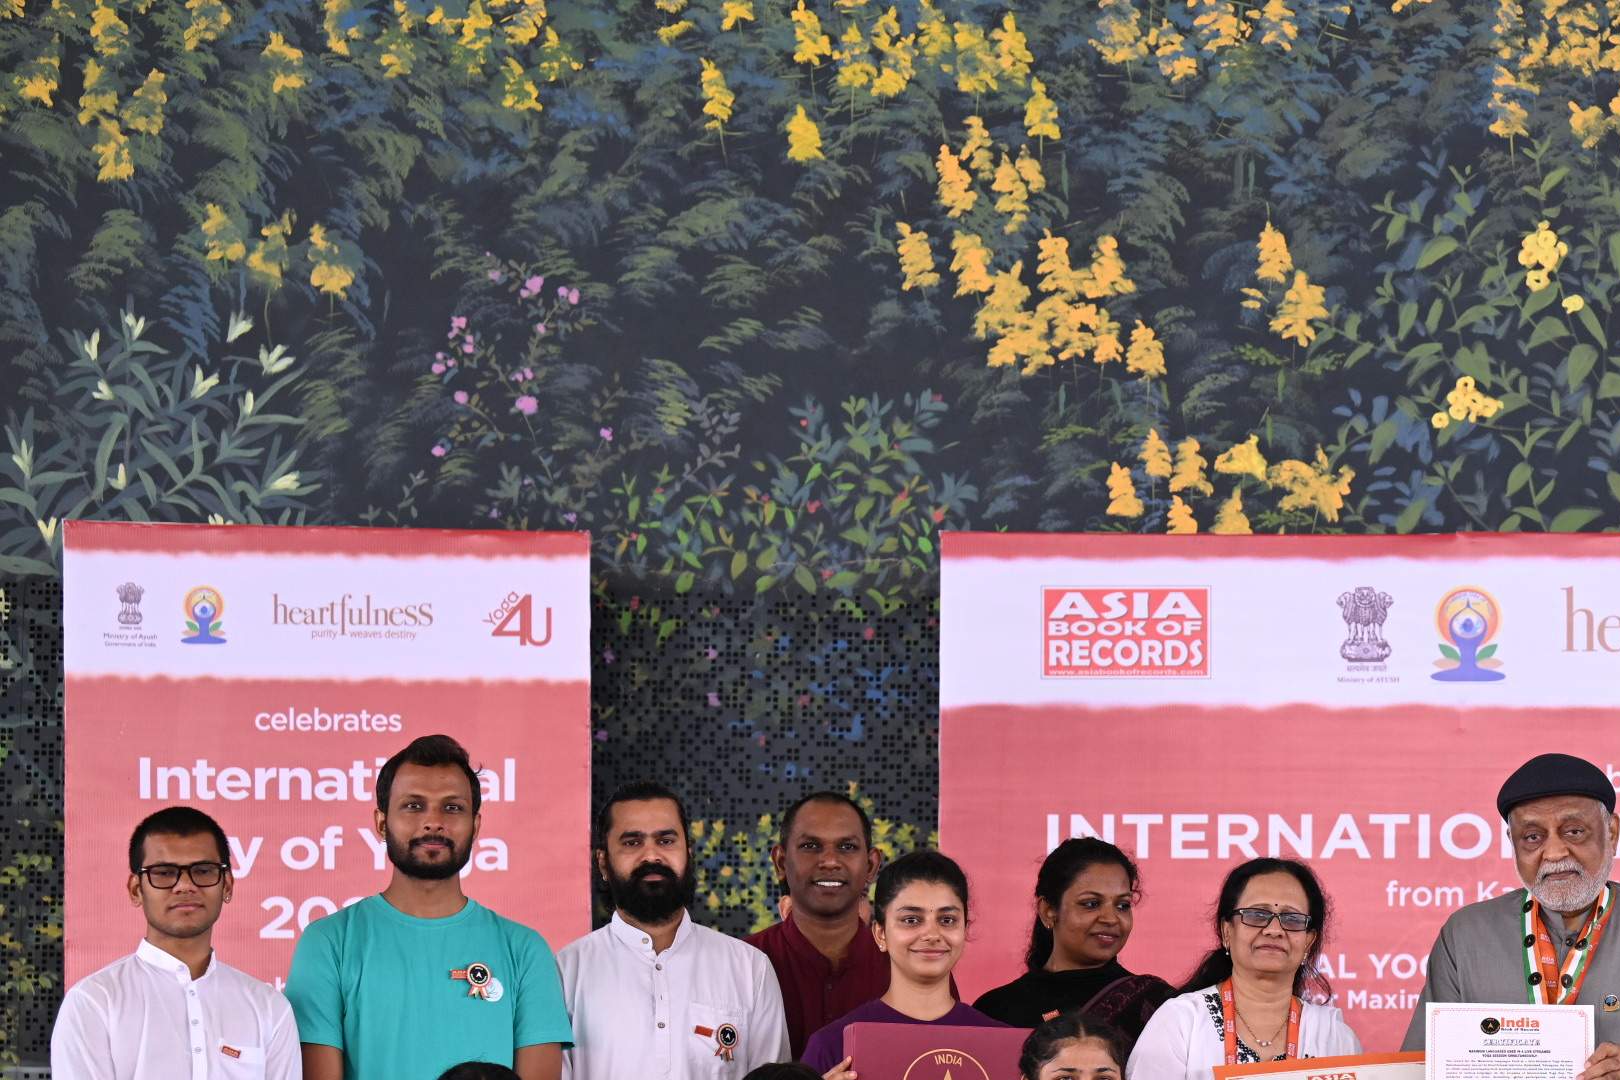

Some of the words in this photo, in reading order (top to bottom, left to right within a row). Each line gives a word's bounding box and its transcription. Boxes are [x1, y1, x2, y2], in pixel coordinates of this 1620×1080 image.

[272, 593, 434, 636] heartfulness
[482, 591, 519, 627] Yoga
[1048, 591, 1203, 619] ASIA
[491, 594, 552, 647] 4U
[1047, 620, 1147, 636] BOOK
[1155, 620, 1203, 636] OF
[311, 629, 338, 641] purity
[350, 630, 383, 640] weaves
[384, 629, 417, 641] destiny
[1048, 638, 1204, 667] RECORDS
[254, 706, 403, 733] celebrates
[138, 756, 516, 801] Internatal
[280, 826, 343, 872] of
[1386, 879, 1464, 907] from
[1500, 1017, 1540, 1028] India
[934, 1053, 963, 1068] INDIA
